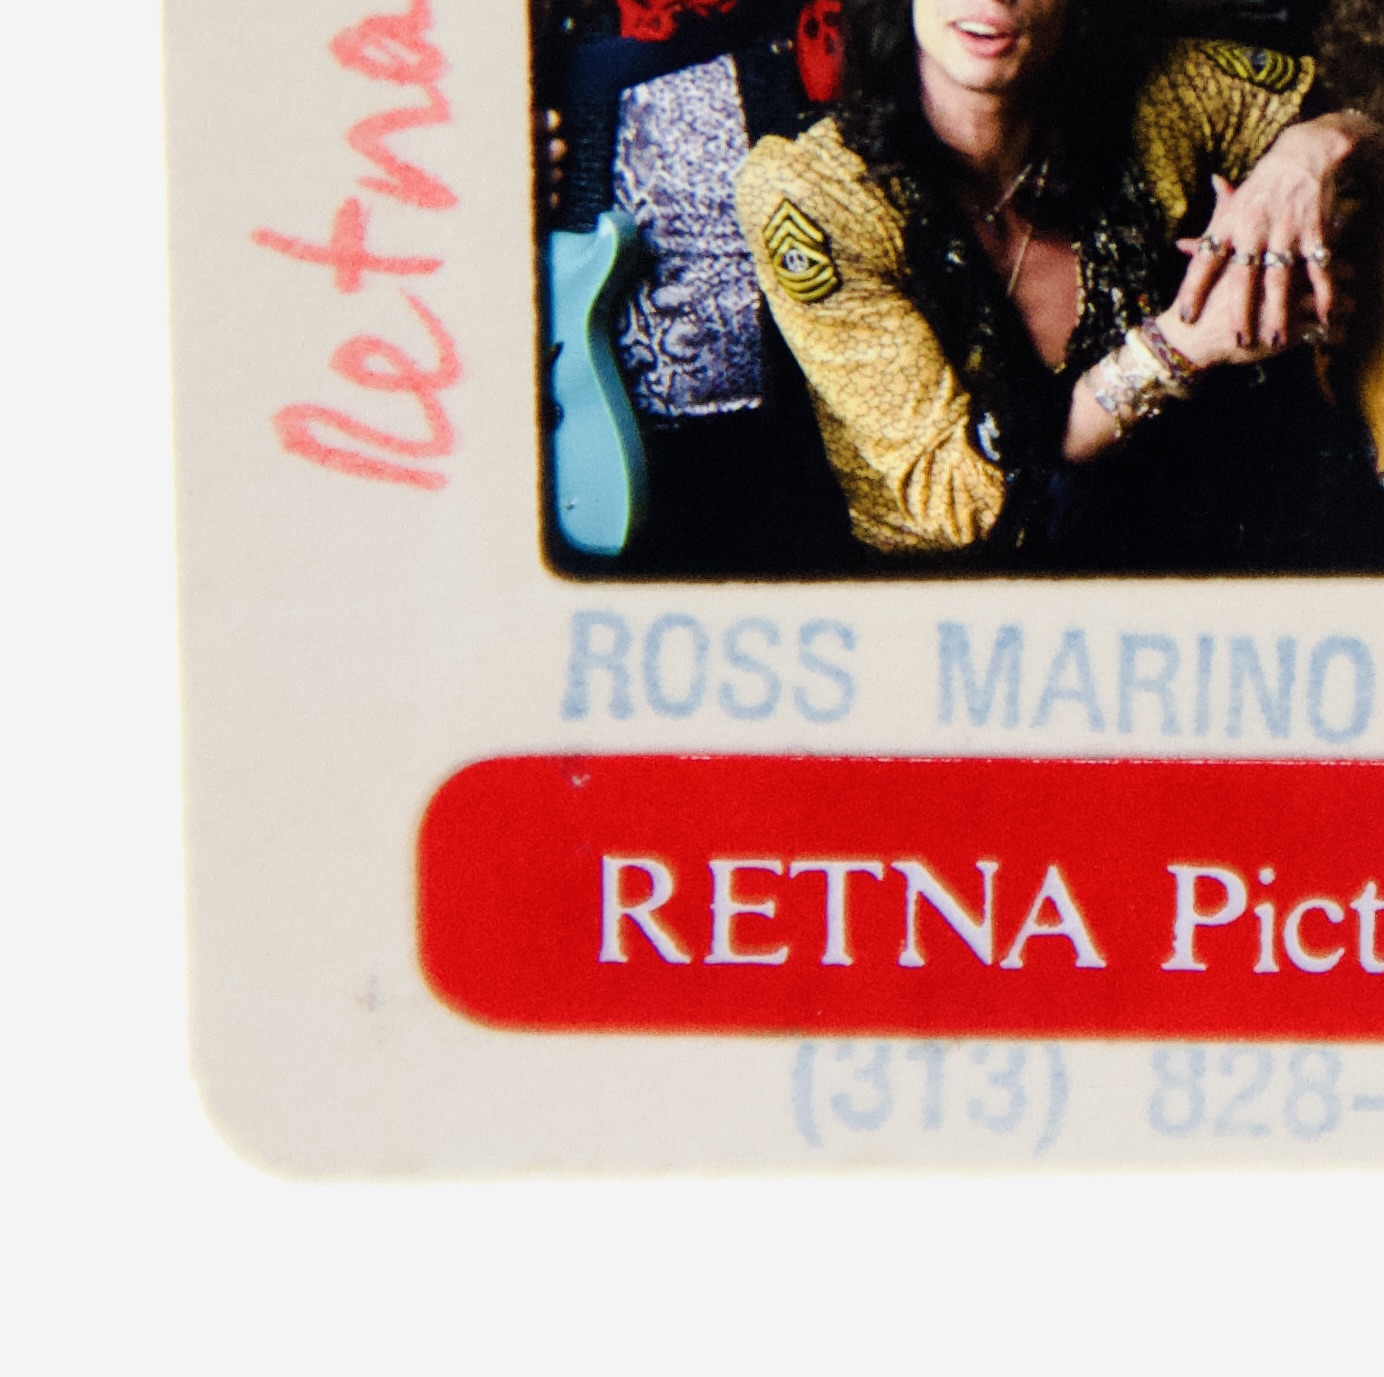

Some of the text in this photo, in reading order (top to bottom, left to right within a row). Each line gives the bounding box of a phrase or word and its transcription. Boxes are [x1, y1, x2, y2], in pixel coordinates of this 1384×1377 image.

[558, 608, 860, 724] ROSS
[934, 620, 1376, 744] MARINO
[599, 854, 1107, 970] RETNA
[790, 1040, 1072, 1154] (313)
